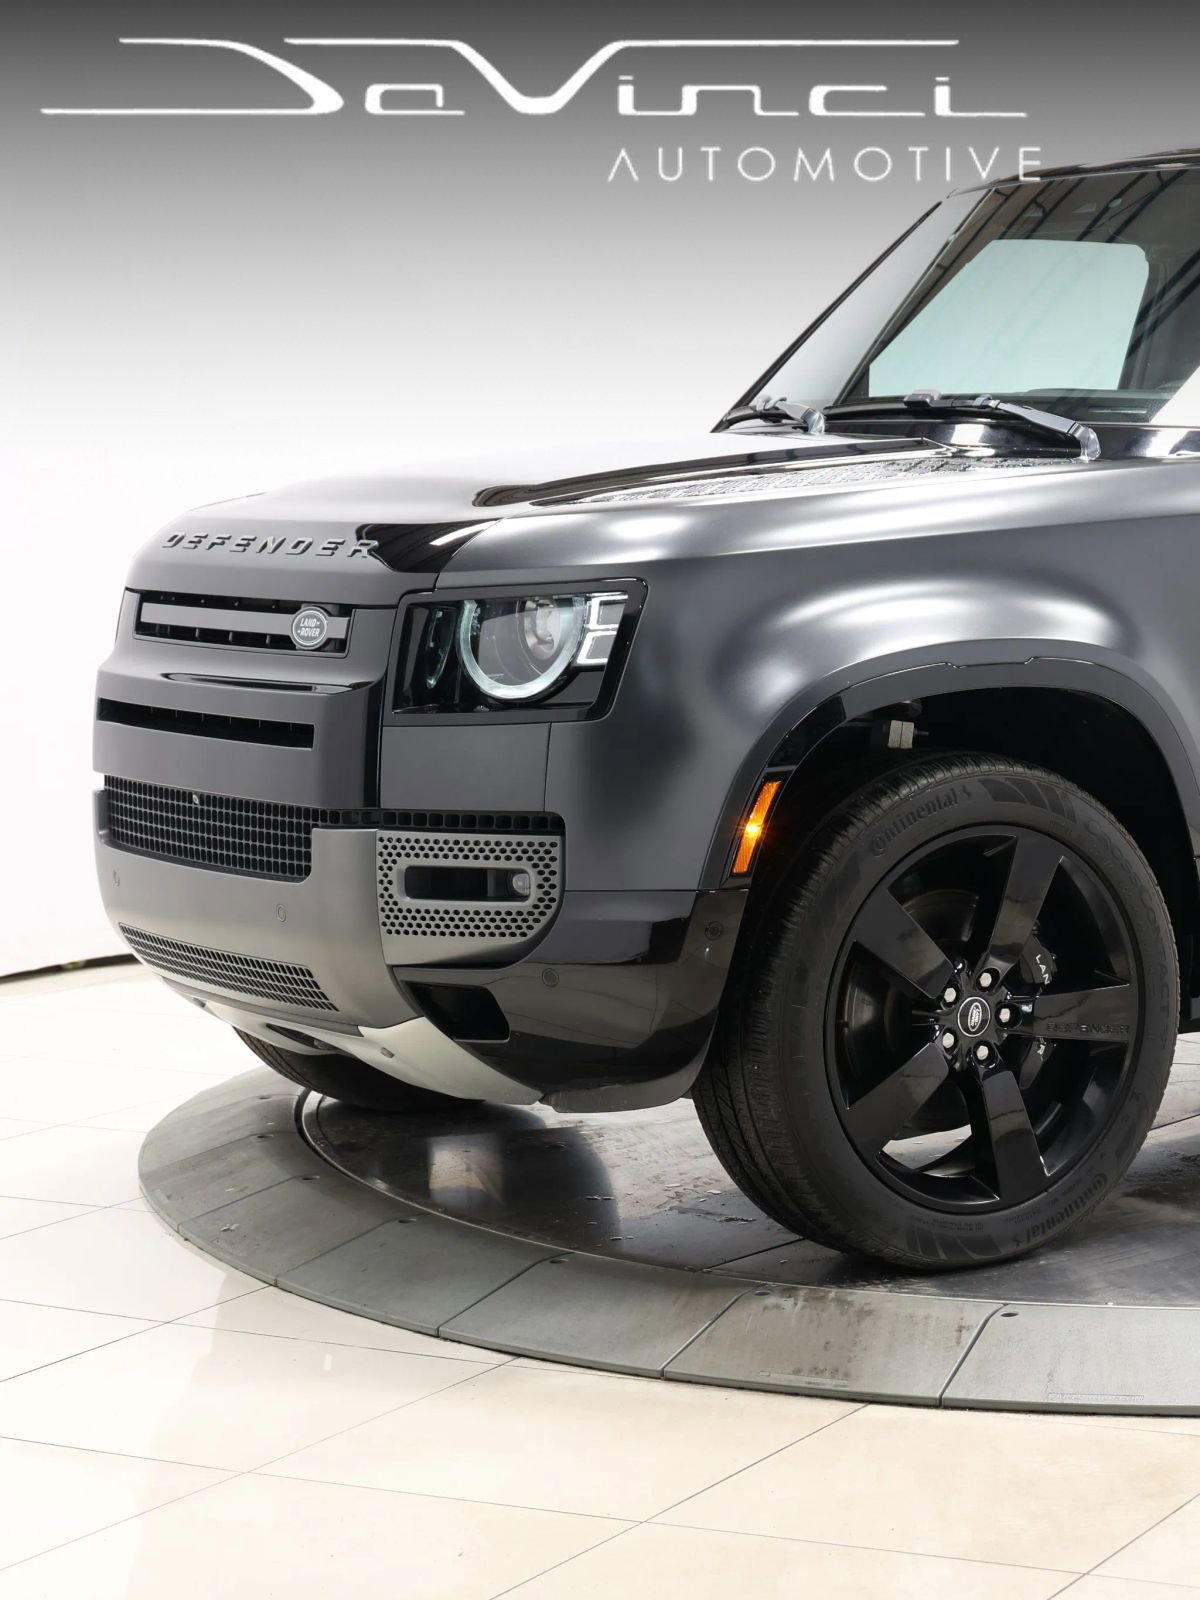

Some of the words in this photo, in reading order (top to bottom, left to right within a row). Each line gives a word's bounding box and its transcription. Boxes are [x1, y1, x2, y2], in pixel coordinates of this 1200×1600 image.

[162, 532, 378, 558] DEFENDER
[869, 790, 960, 857] Continental
[1035, 953, 1051, 985] LAN
[1025, 1172, 1108, 1239] Continental
